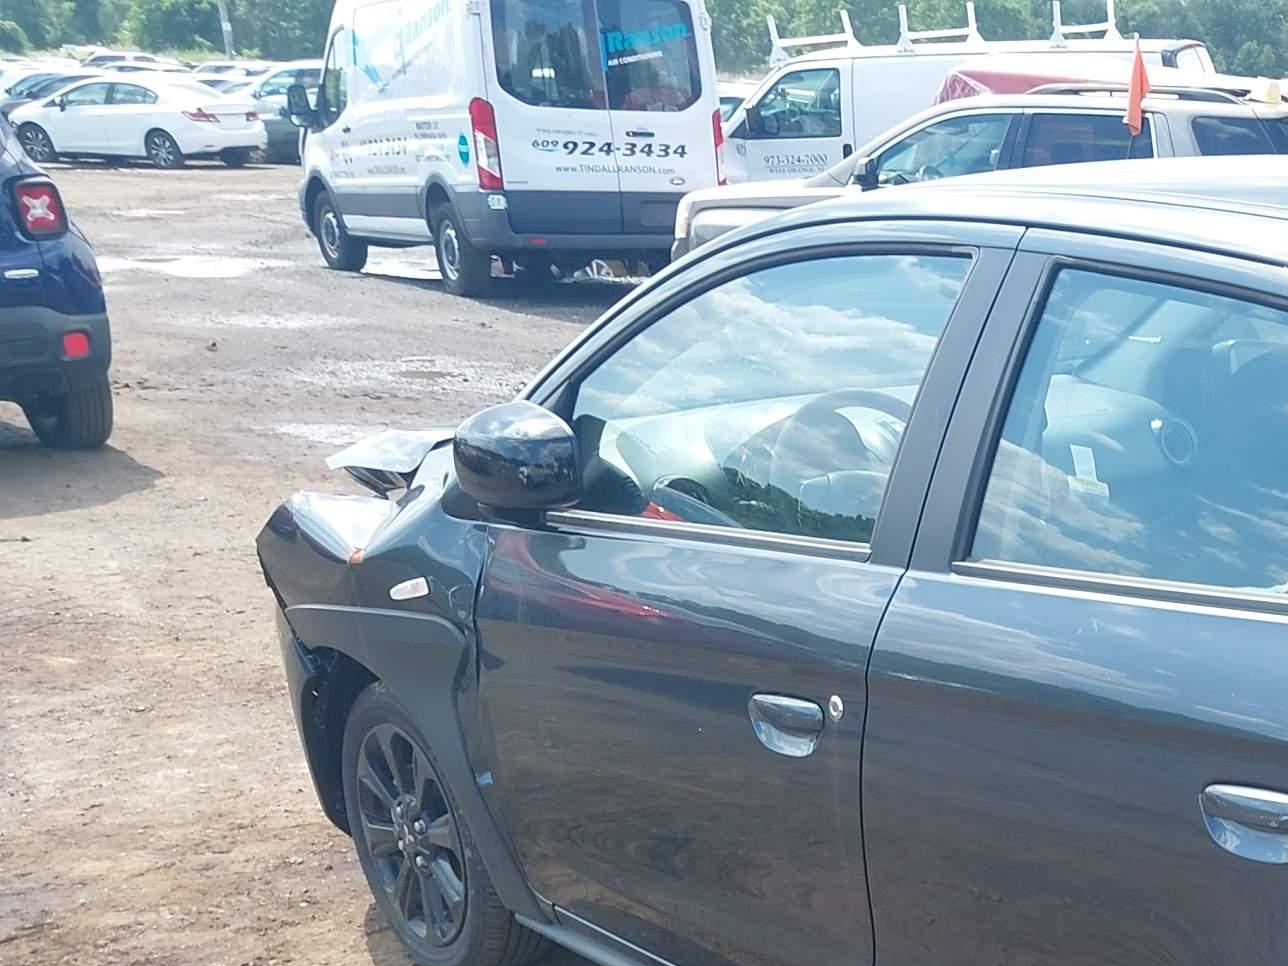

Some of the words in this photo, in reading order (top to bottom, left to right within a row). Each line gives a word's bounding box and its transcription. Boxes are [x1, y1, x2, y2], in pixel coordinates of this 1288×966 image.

[607, 22, 689, 52] Ranson
[531, 139, 559, 149] 609
[562, 140, 688, 158] 924-3434
[763, 153, 828, 165] 973-324-7000
[554, 164, 676, 175] www.TINDALLRANSON.com
